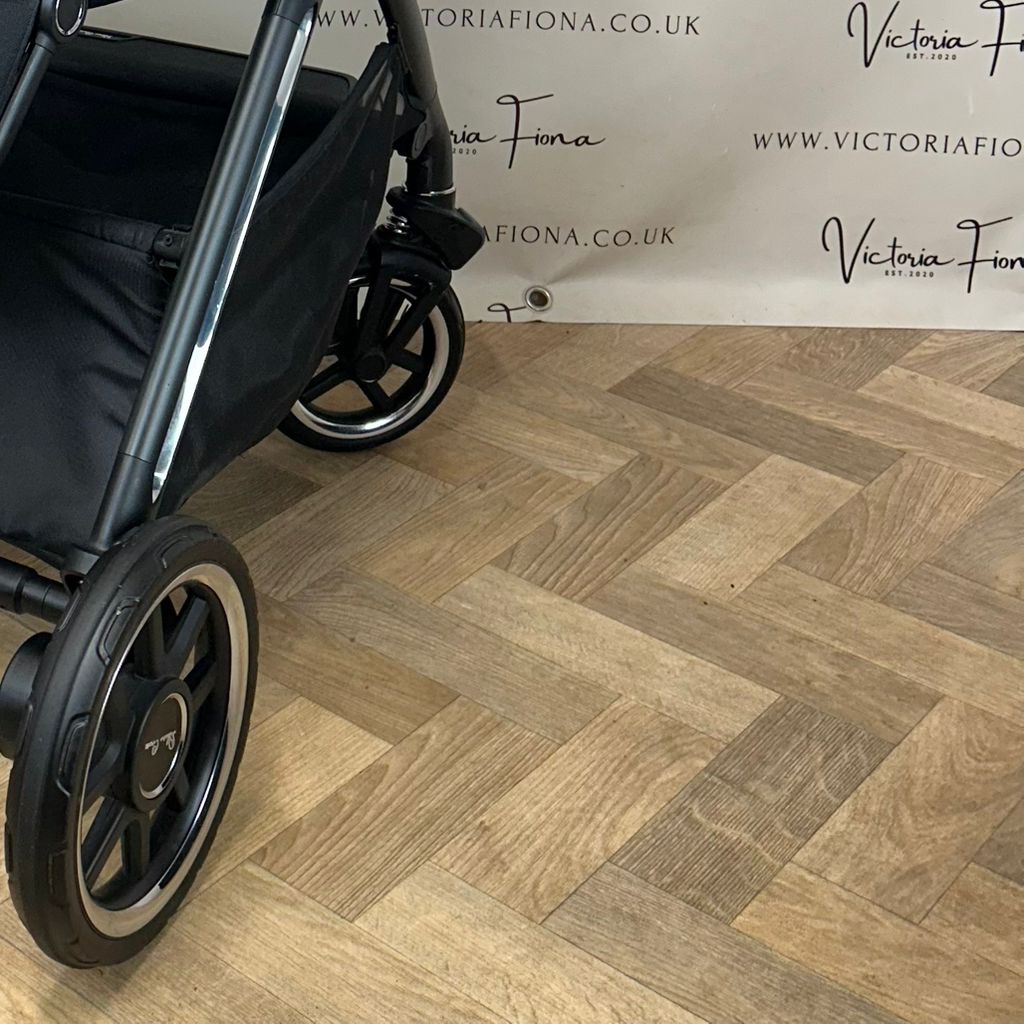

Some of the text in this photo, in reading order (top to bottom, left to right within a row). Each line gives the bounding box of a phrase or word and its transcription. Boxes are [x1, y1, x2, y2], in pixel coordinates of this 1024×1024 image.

[847, 0, 979, 68] Victoria
[906, 53, 957, 61] EST.2020
[496, 94, 606, 169] Fiona
[822, 216, 955, 284] Victoria
[885, 270, 935, 278] EST.2020
